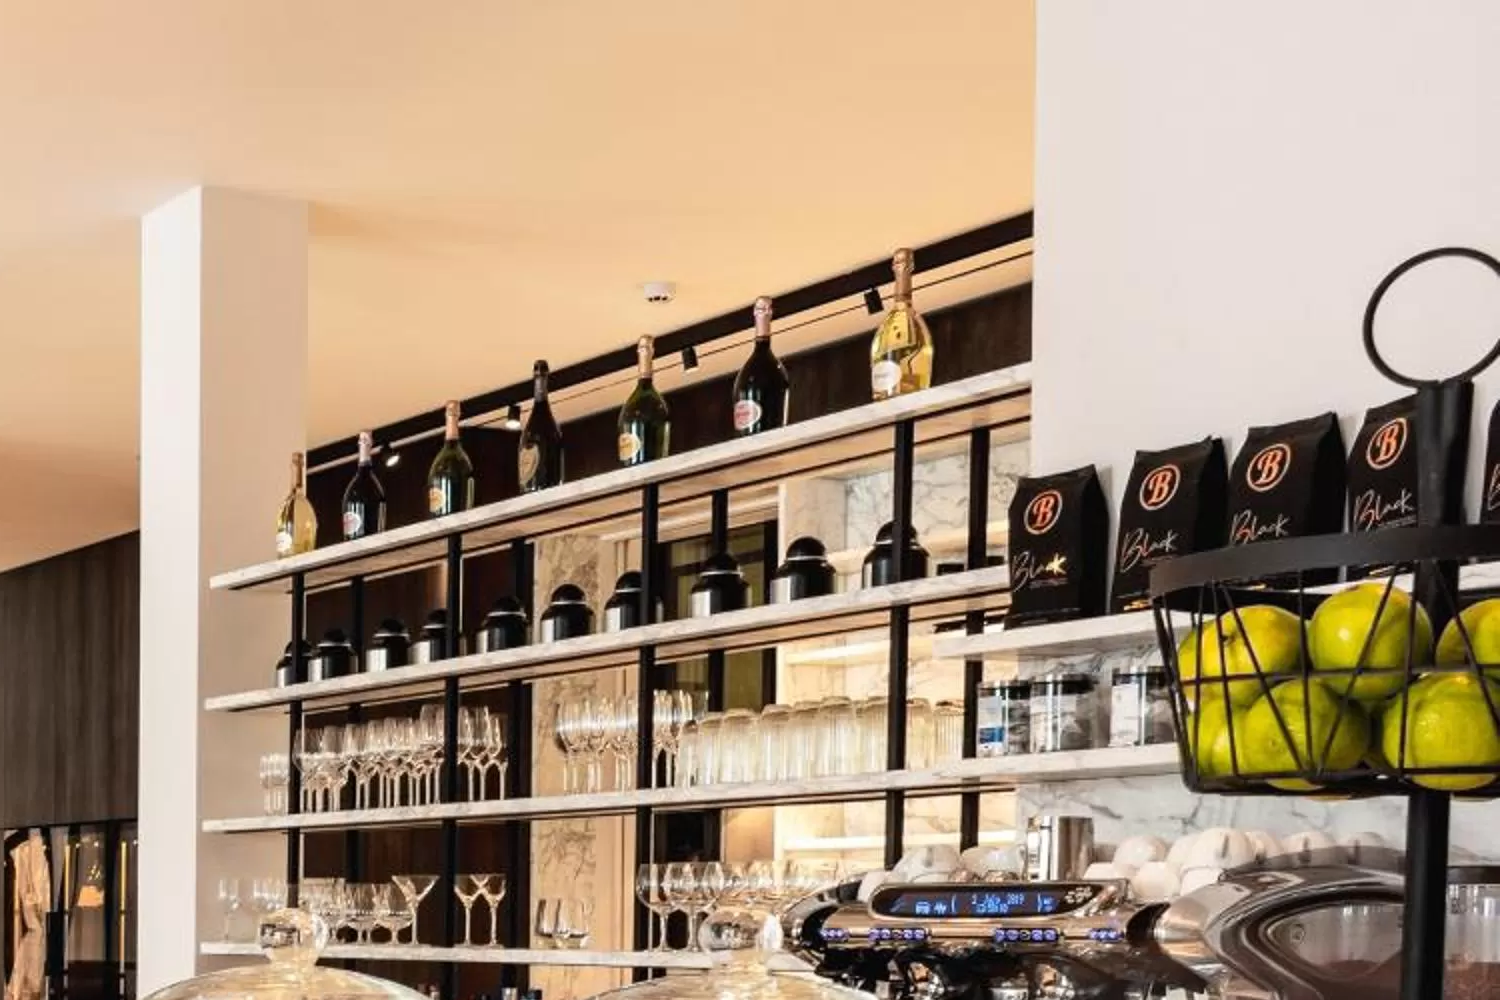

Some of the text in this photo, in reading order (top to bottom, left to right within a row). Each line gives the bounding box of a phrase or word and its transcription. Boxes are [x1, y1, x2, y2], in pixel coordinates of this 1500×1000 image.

[1230, 509, 1290, 544] Black
[1353, 488, 1414, 534] Black
[1121, 527, 1178, 572] Black
